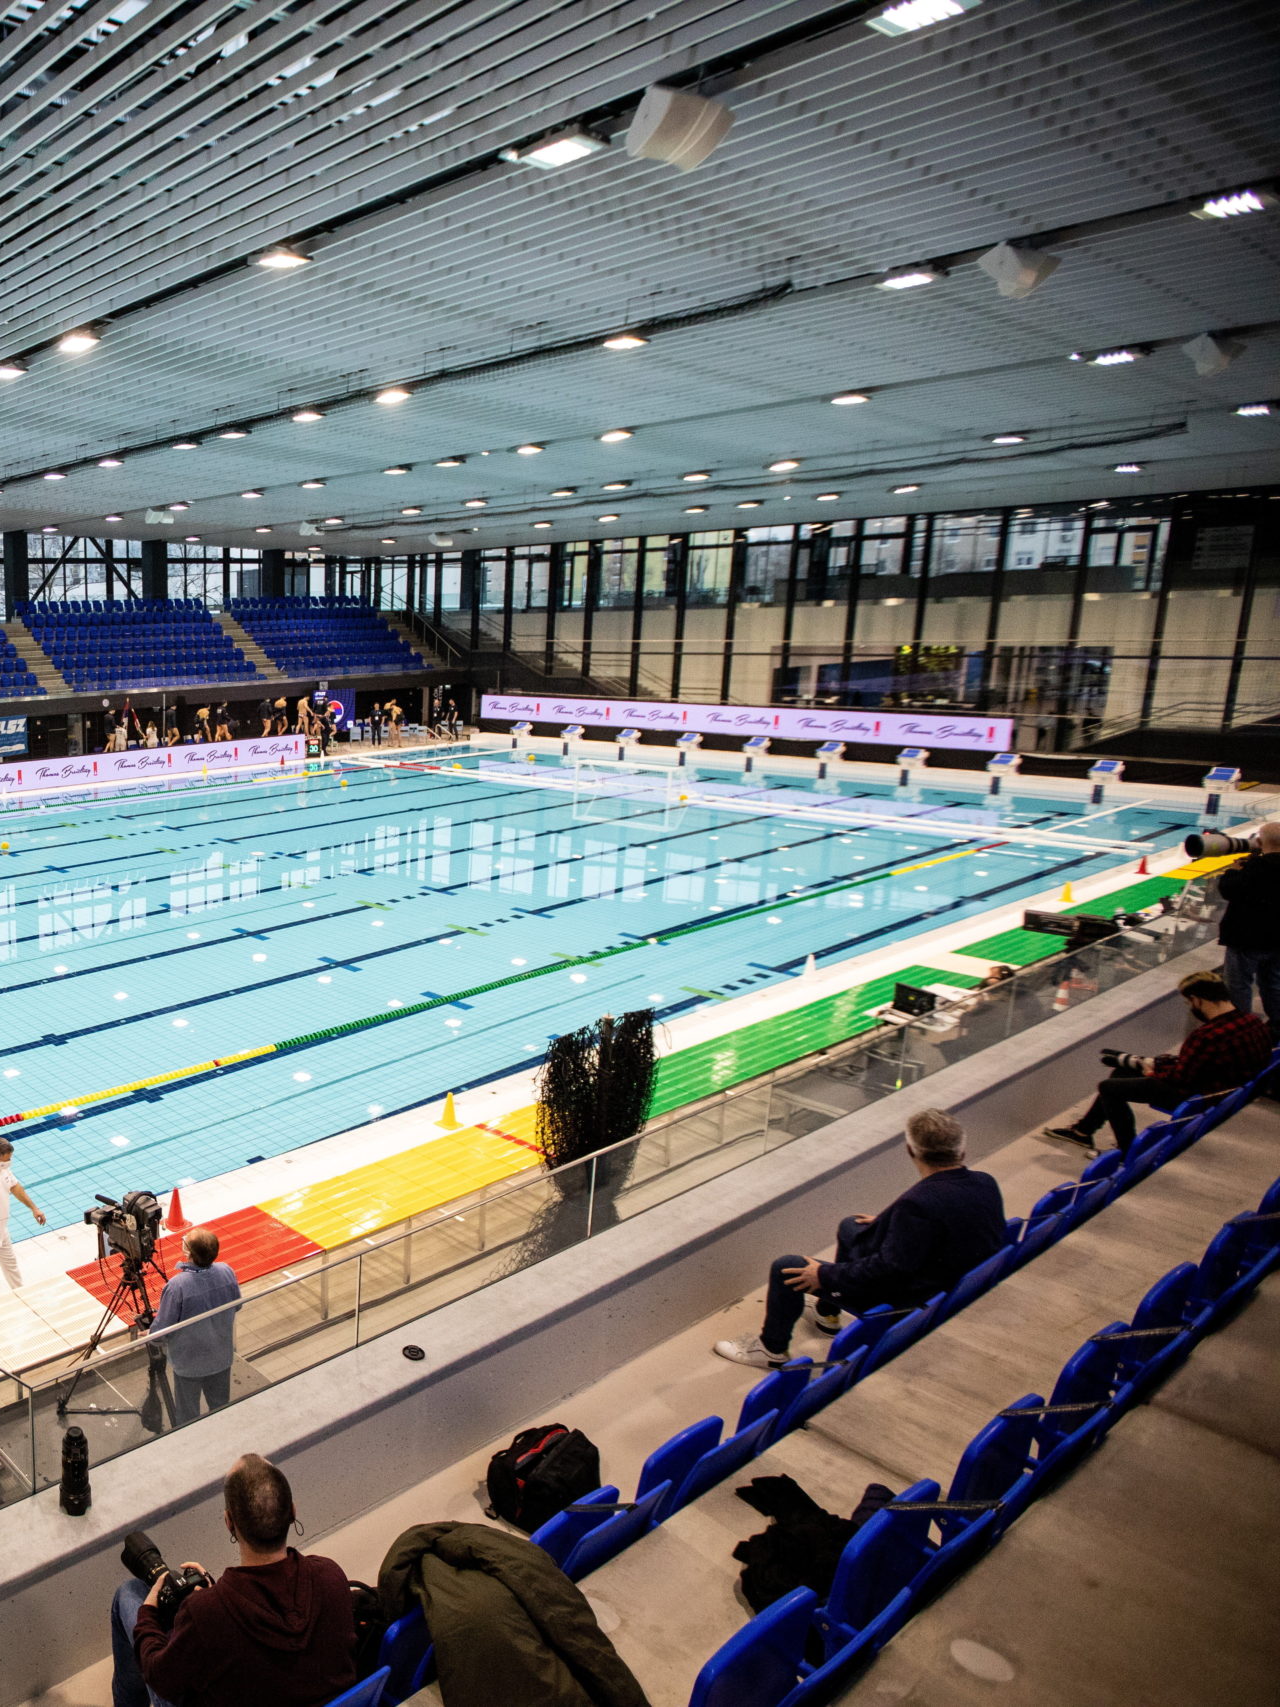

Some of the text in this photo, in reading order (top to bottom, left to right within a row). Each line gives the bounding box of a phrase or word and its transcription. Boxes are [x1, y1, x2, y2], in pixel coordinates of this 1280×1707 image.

[184, 751, 205, 764] Thomas
[248, 745, 268, 757] Thomas
[114, 758, 137, 772] Thomas
[35, 766, 59, 781] Thomas
